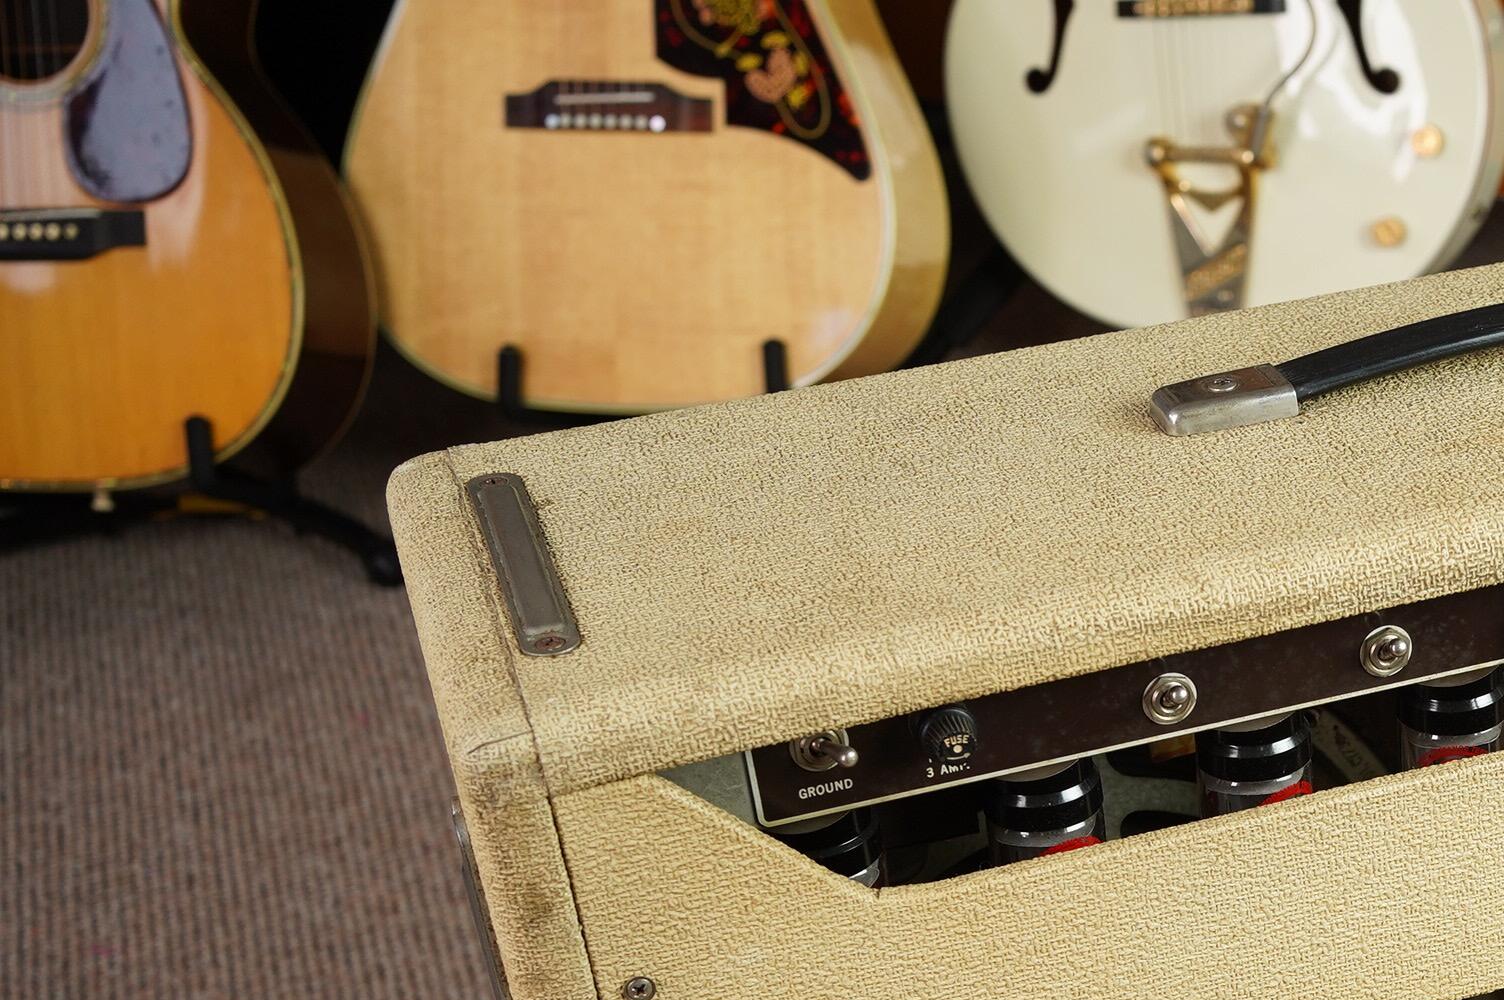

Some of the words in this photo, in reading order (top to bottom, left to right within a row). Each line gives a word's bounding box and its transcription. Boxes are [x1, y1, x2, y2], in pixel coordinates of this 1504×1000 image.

[943, 734, 970, 747] FUSE
[926, 767, 935, 778] 3
[798, 777, 854, 800] GROUND
